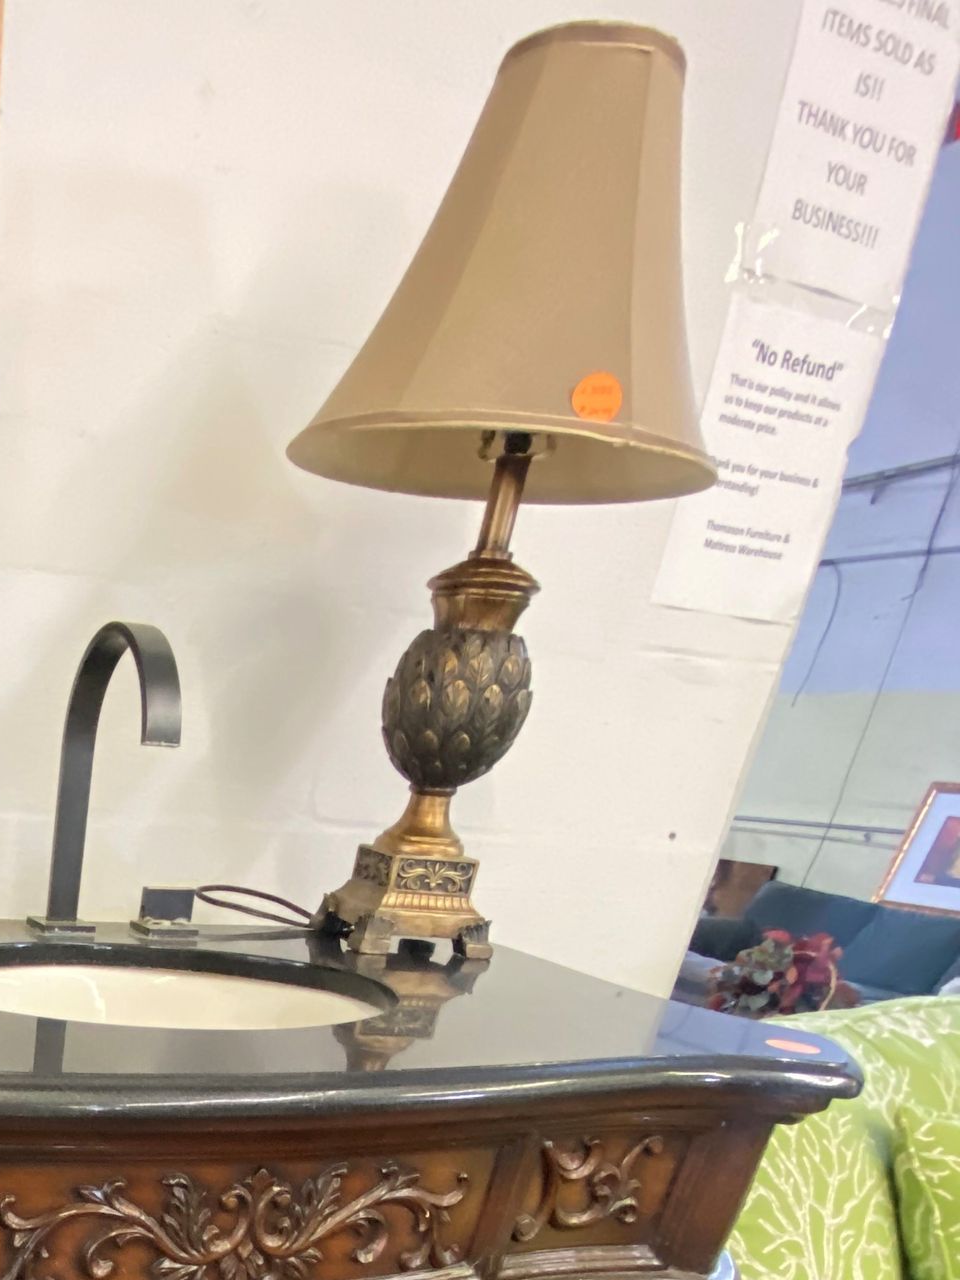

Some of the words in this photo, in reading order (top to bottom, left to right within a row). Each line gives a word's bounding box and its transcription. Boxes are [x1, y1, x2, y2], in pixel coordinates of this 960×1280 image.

[821, 8, 872, 48] ITEMS
[874, 29, 913, 66] SOLD
[915, 50, 936, 75] AS
[854, 72, 885, 101] IS!!
[797, 100, 849, 141] THANK
[850, 123, 887, 155] YOU
[887, 138, 917, 167] FOR
[826, 161, 868, 195] YOUR
[792, 198, 879, 250] BUSINESS!!!
